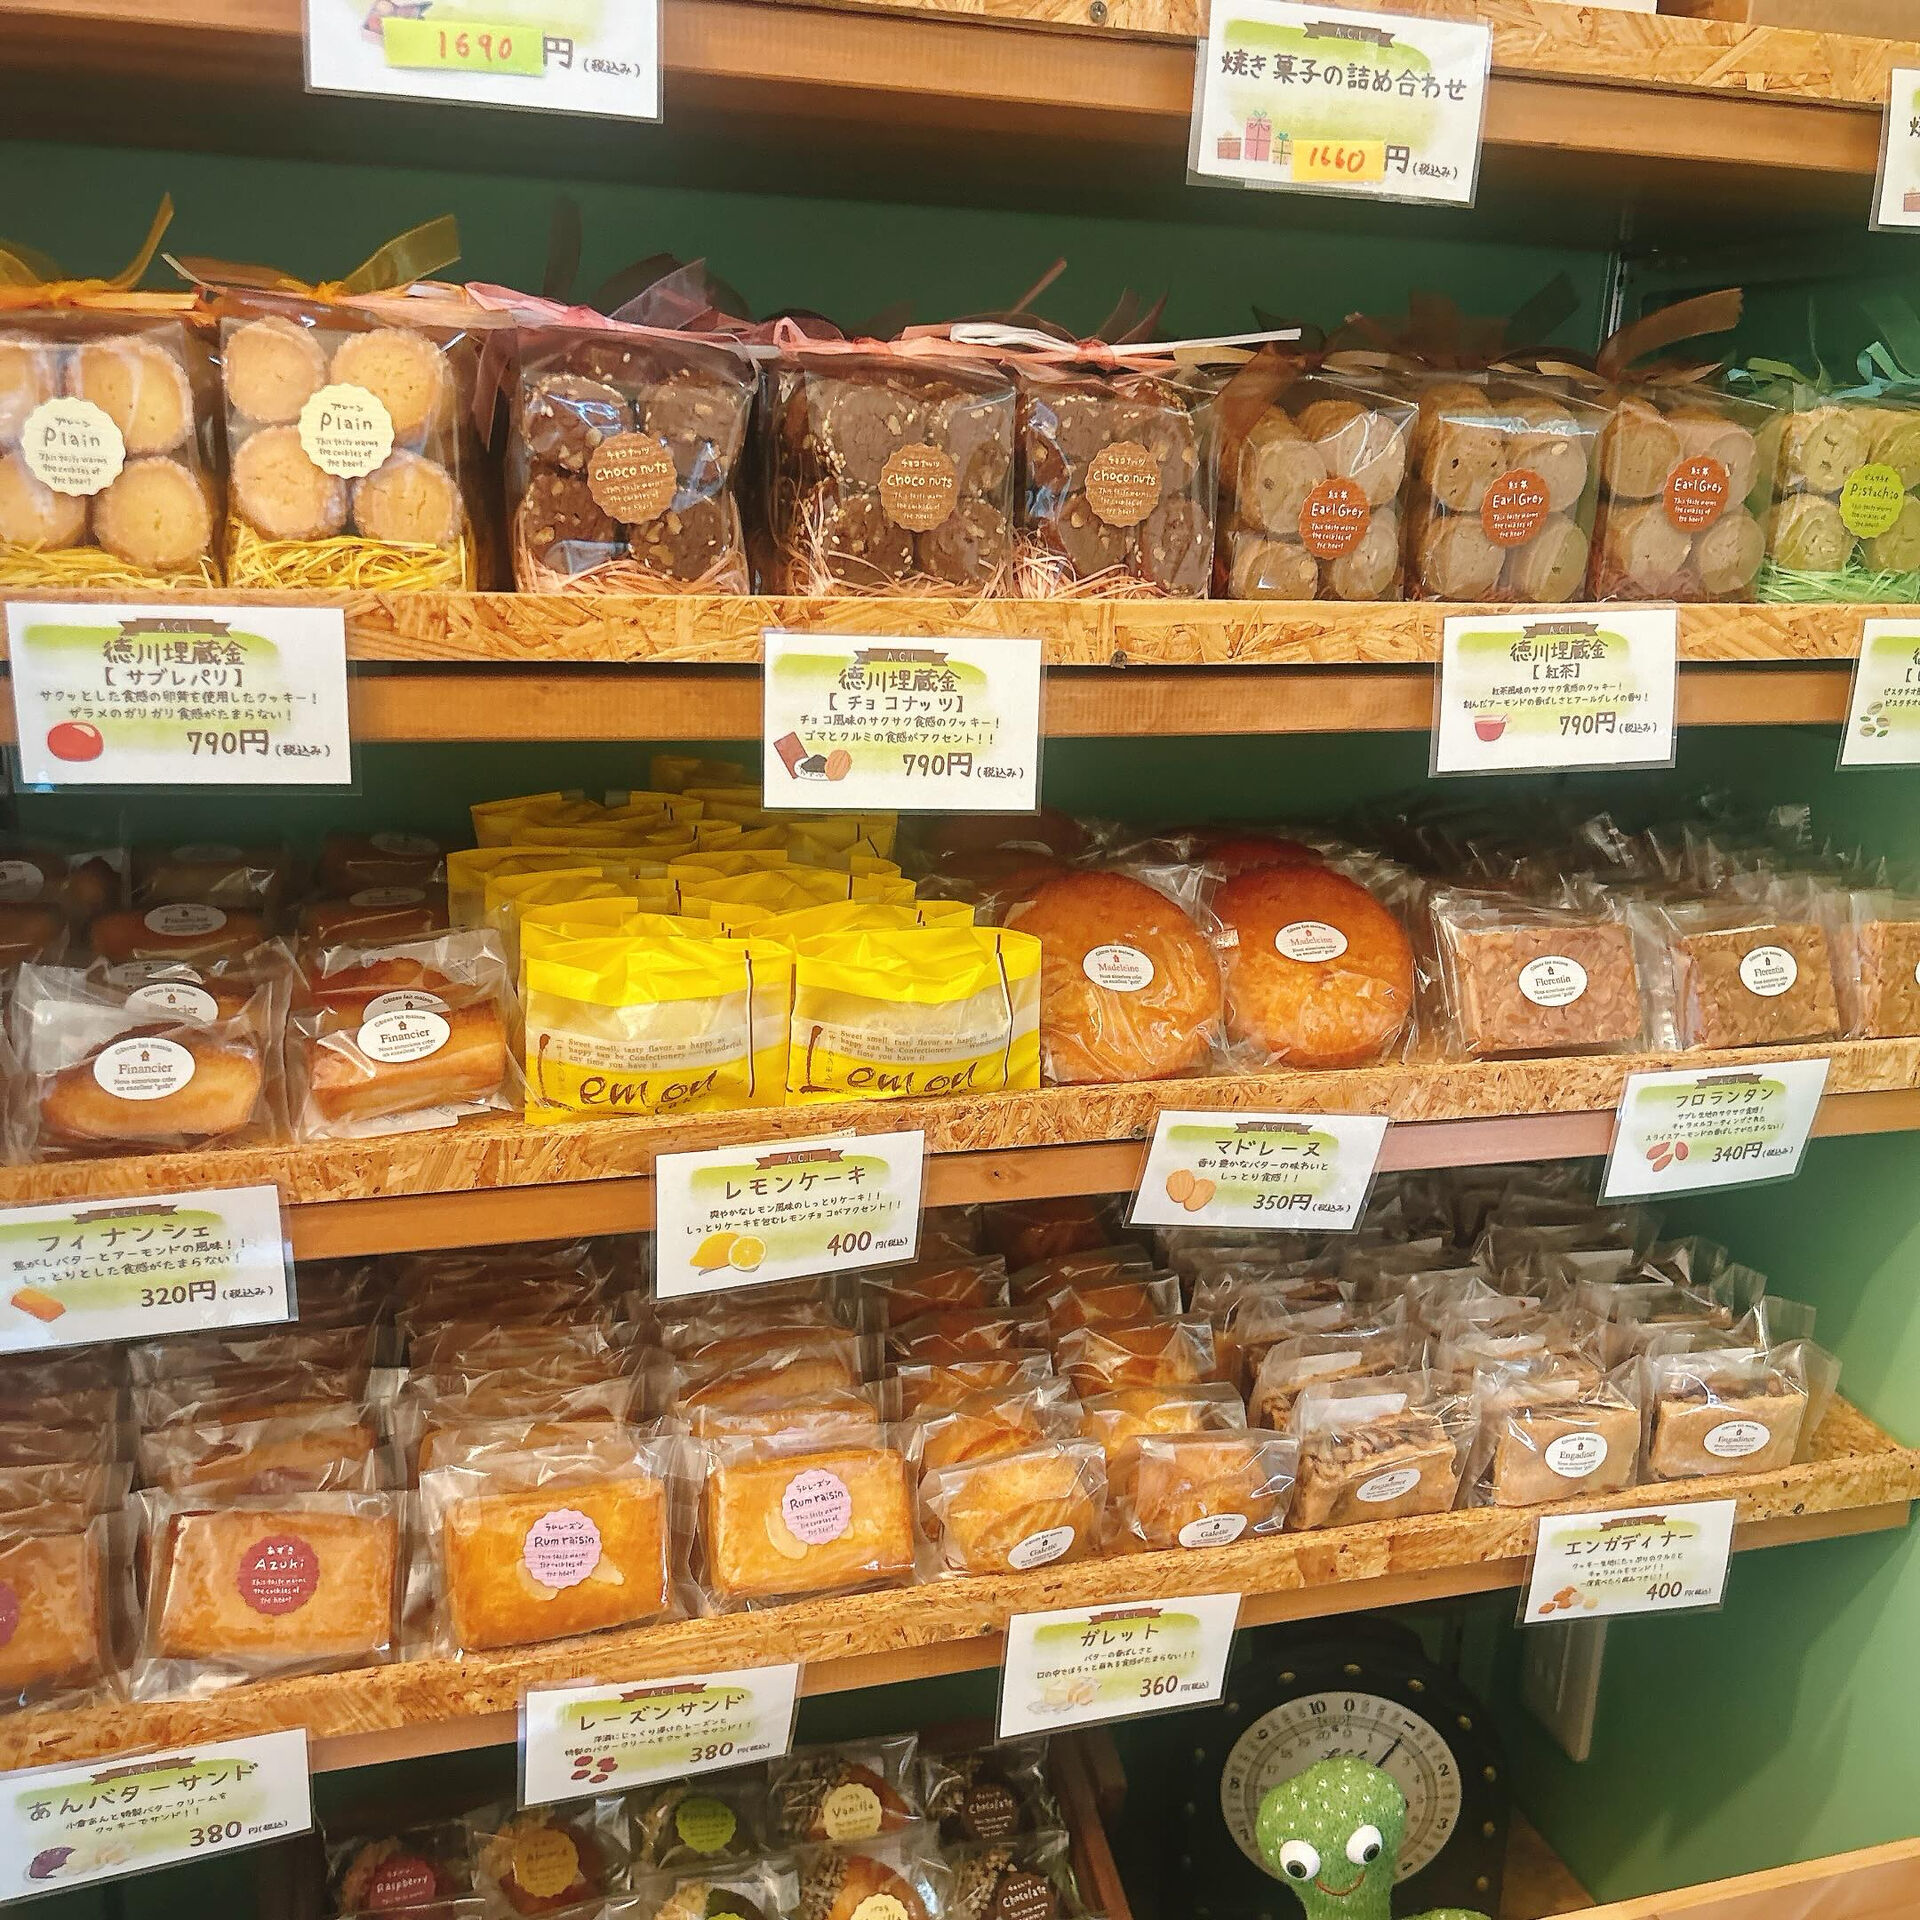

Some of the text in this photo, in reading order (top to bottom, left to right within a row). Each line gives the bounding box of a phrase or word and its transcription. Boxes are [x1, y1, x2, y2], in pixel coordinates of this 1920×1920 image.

[439, 31, 513, 62] 1690
[544, 36, 573, 69] 円
[1221, 49, 1467, 101] 焼き菓子の詰め合わせ
[1309, 147, 1365, 173] 1660
[1384, 145, 1410, 174] 円
[320, 411, 373, 431] Plain
[44, 426, 101, 448] Plain
[595, 461, 668, 481] Choco nuts
[887, 473, 952, 488] Choco nuts
[1093, 470, 1156, 486] Choco nuts
[1674, 478, 1723, 494] Earl Grey
[1311, 503, 1365, 518] Earl Grey
[1492, 493, 1544, 508] Earl Grey
[103, 639, 248, 666] 徳川埋蔵金
[1510, 638, 1608, 663] 徳川埋蔵金
[838, 666, 962, 693] 徳川埋蔵金
[1560, 711, 1616, 736] 790円
[187, 729, 269, 756] 790円
[903, 752, 972, 777] 790円
[380, 1029, 430, 1043] Financier
[119, 1063, 173, 1075] Financier
[800, 1026, 977, 1095] Lemon
[1676, 1087, 1774, 1108] フロランタン
[1215, 1138, 1320, 1156] マドレーヌ
[1712, 1141, 1762, 1164] 340円
[726, 1165, 866, 1200] レモンケーキ
[1253, 1193, 1312, 1211] 350円
[38, 1223, 210, 1252] フィナンシェ
[827, 1230, 872, 1256] 400
[141, 1279, 216, 1308] 320円
[790, 1490, 844, 1511] Rum raisin
[534, 1536, 595, 1547] Rum raisin
[1565, 1531, 1693, 1556] エンガディナー
[254, 1558, 304, 1570] Azuki
[1646, 1581, 1683, 1601] 400
[1081, 1623, 1159, 1648] ガレット
[1140, 1675, 1178, 1698] 360
[580, 1693, 745, 1731] レーズンサンド
[1309, 1700, 1326, 1715] 10
[1344, 1699, 1355, 1713] 0
[690, 1741, 733, 1764] 380
[1439, 1763, 1450, 1777] 2
[30, 1762, 258, 1822] あんバターサンド
[832, 1800, 873, 1818] Vanilla
[190, 1820, 242, 1848] 380
[1436, 1818, 1449, 1830] 3
[376, 1875, 428, 1894] Raspberry
